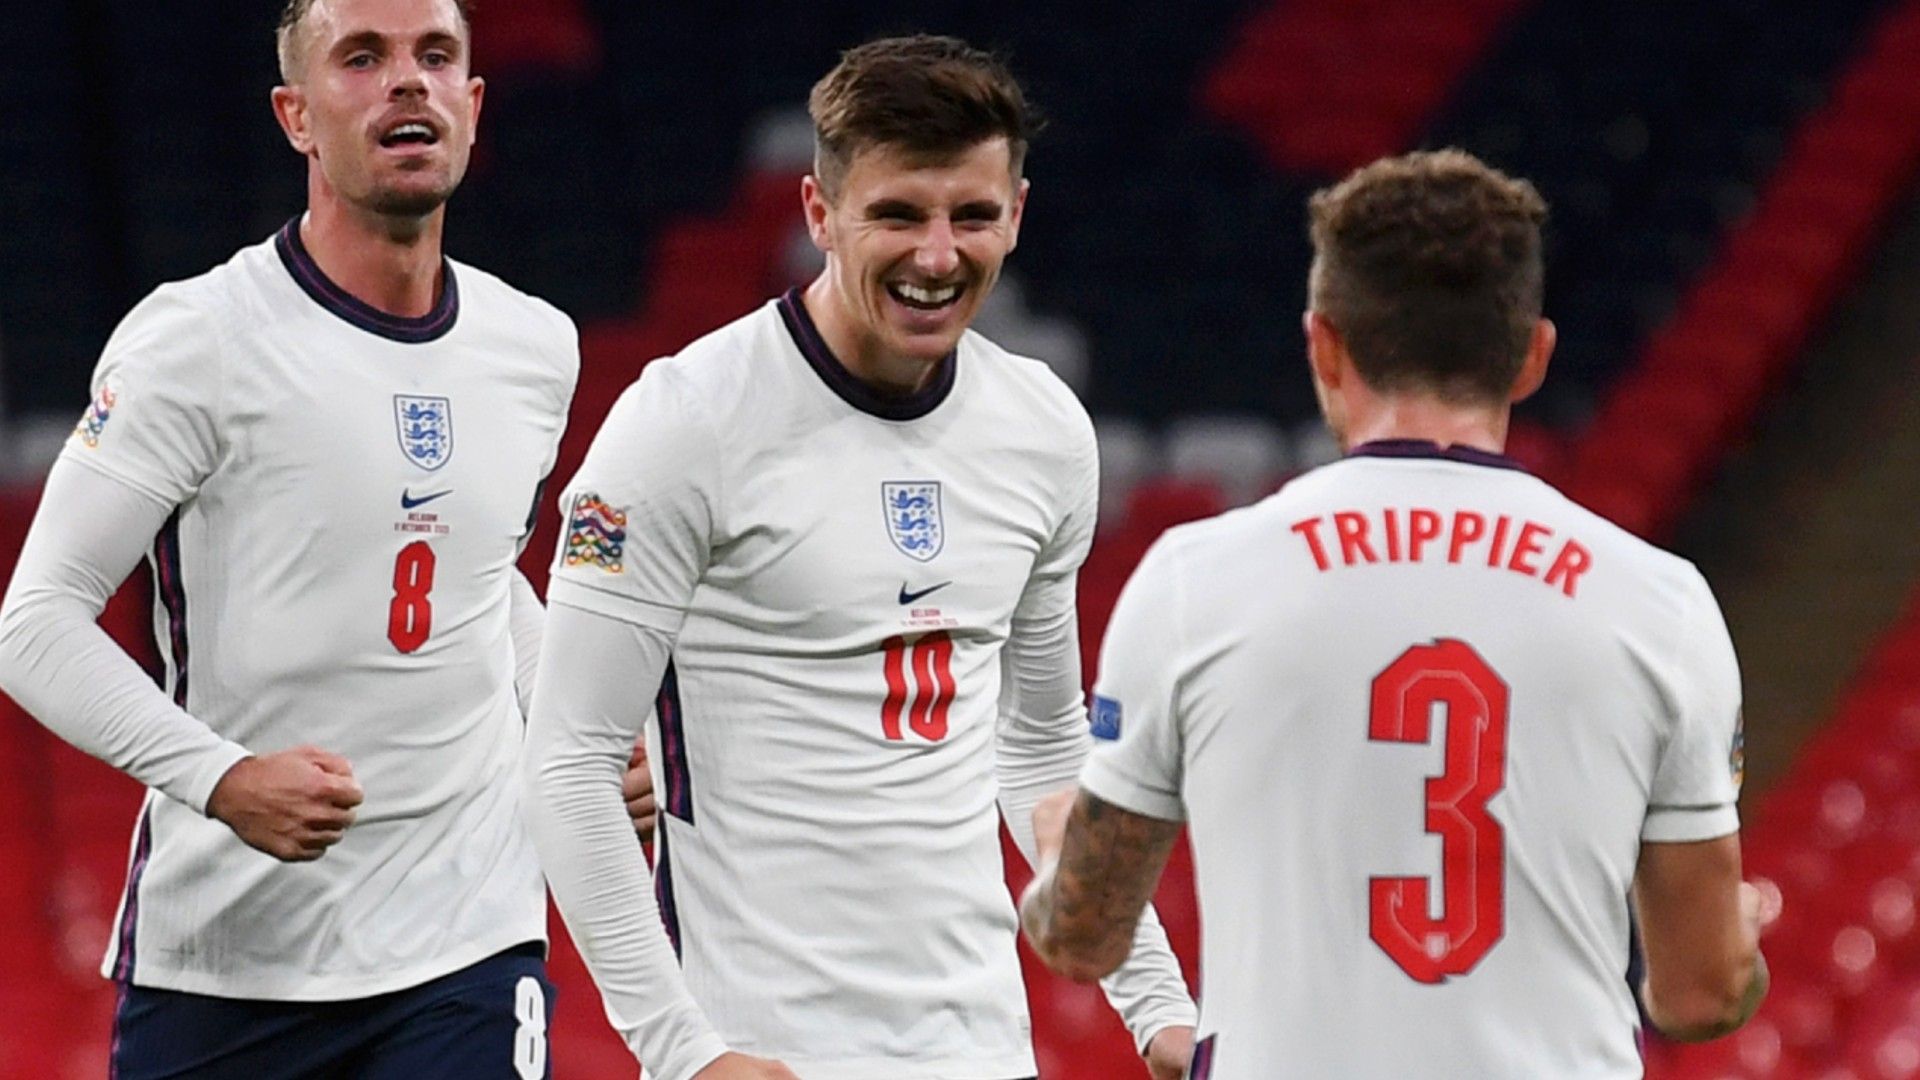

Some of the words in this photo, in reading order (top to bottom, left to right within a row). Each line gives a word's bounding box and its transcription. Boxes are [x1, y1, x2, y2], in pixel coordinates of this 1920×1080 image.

[387, 540, 436, 654] 8
[1290, 508, 1594, 599] TRIPPIER
[881, 630, 957, 742] 10
[1368, 637, 1512, 985] 3
[513, 976, 547, 1080] 8
